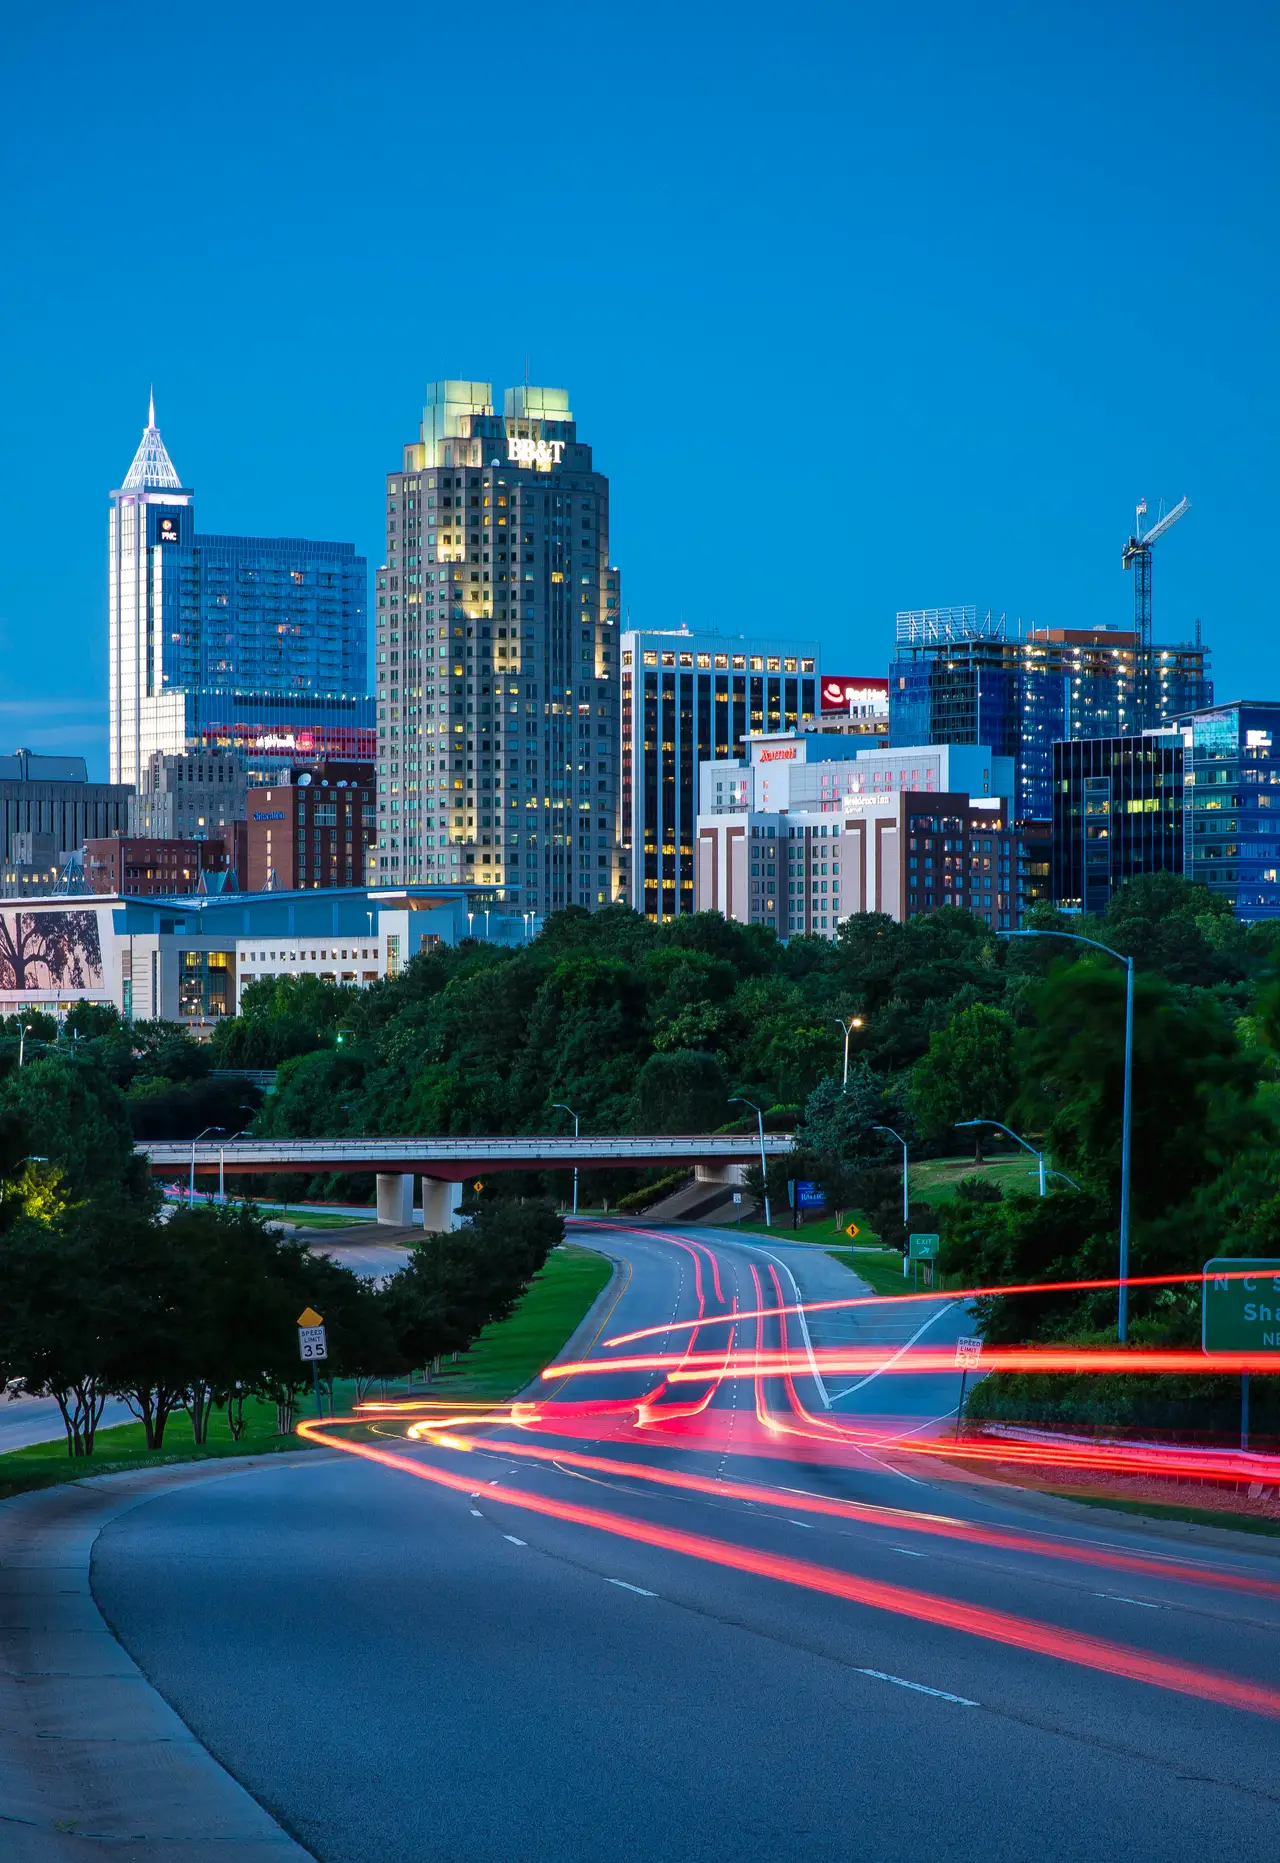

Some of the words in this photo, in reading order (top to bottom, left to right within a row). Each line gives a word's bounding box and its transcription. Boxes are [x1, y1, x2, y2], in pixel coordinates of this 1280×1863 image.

[507, 438, 565, 463] BB&T
[161, 532, 177, 540] PNC
[845, 688, 867, 701] Red
[959, 1339, 981, 1347] SPEED
[304, 1344, 325, 1357] 35
[958, 1353, 979, 1366] 35
